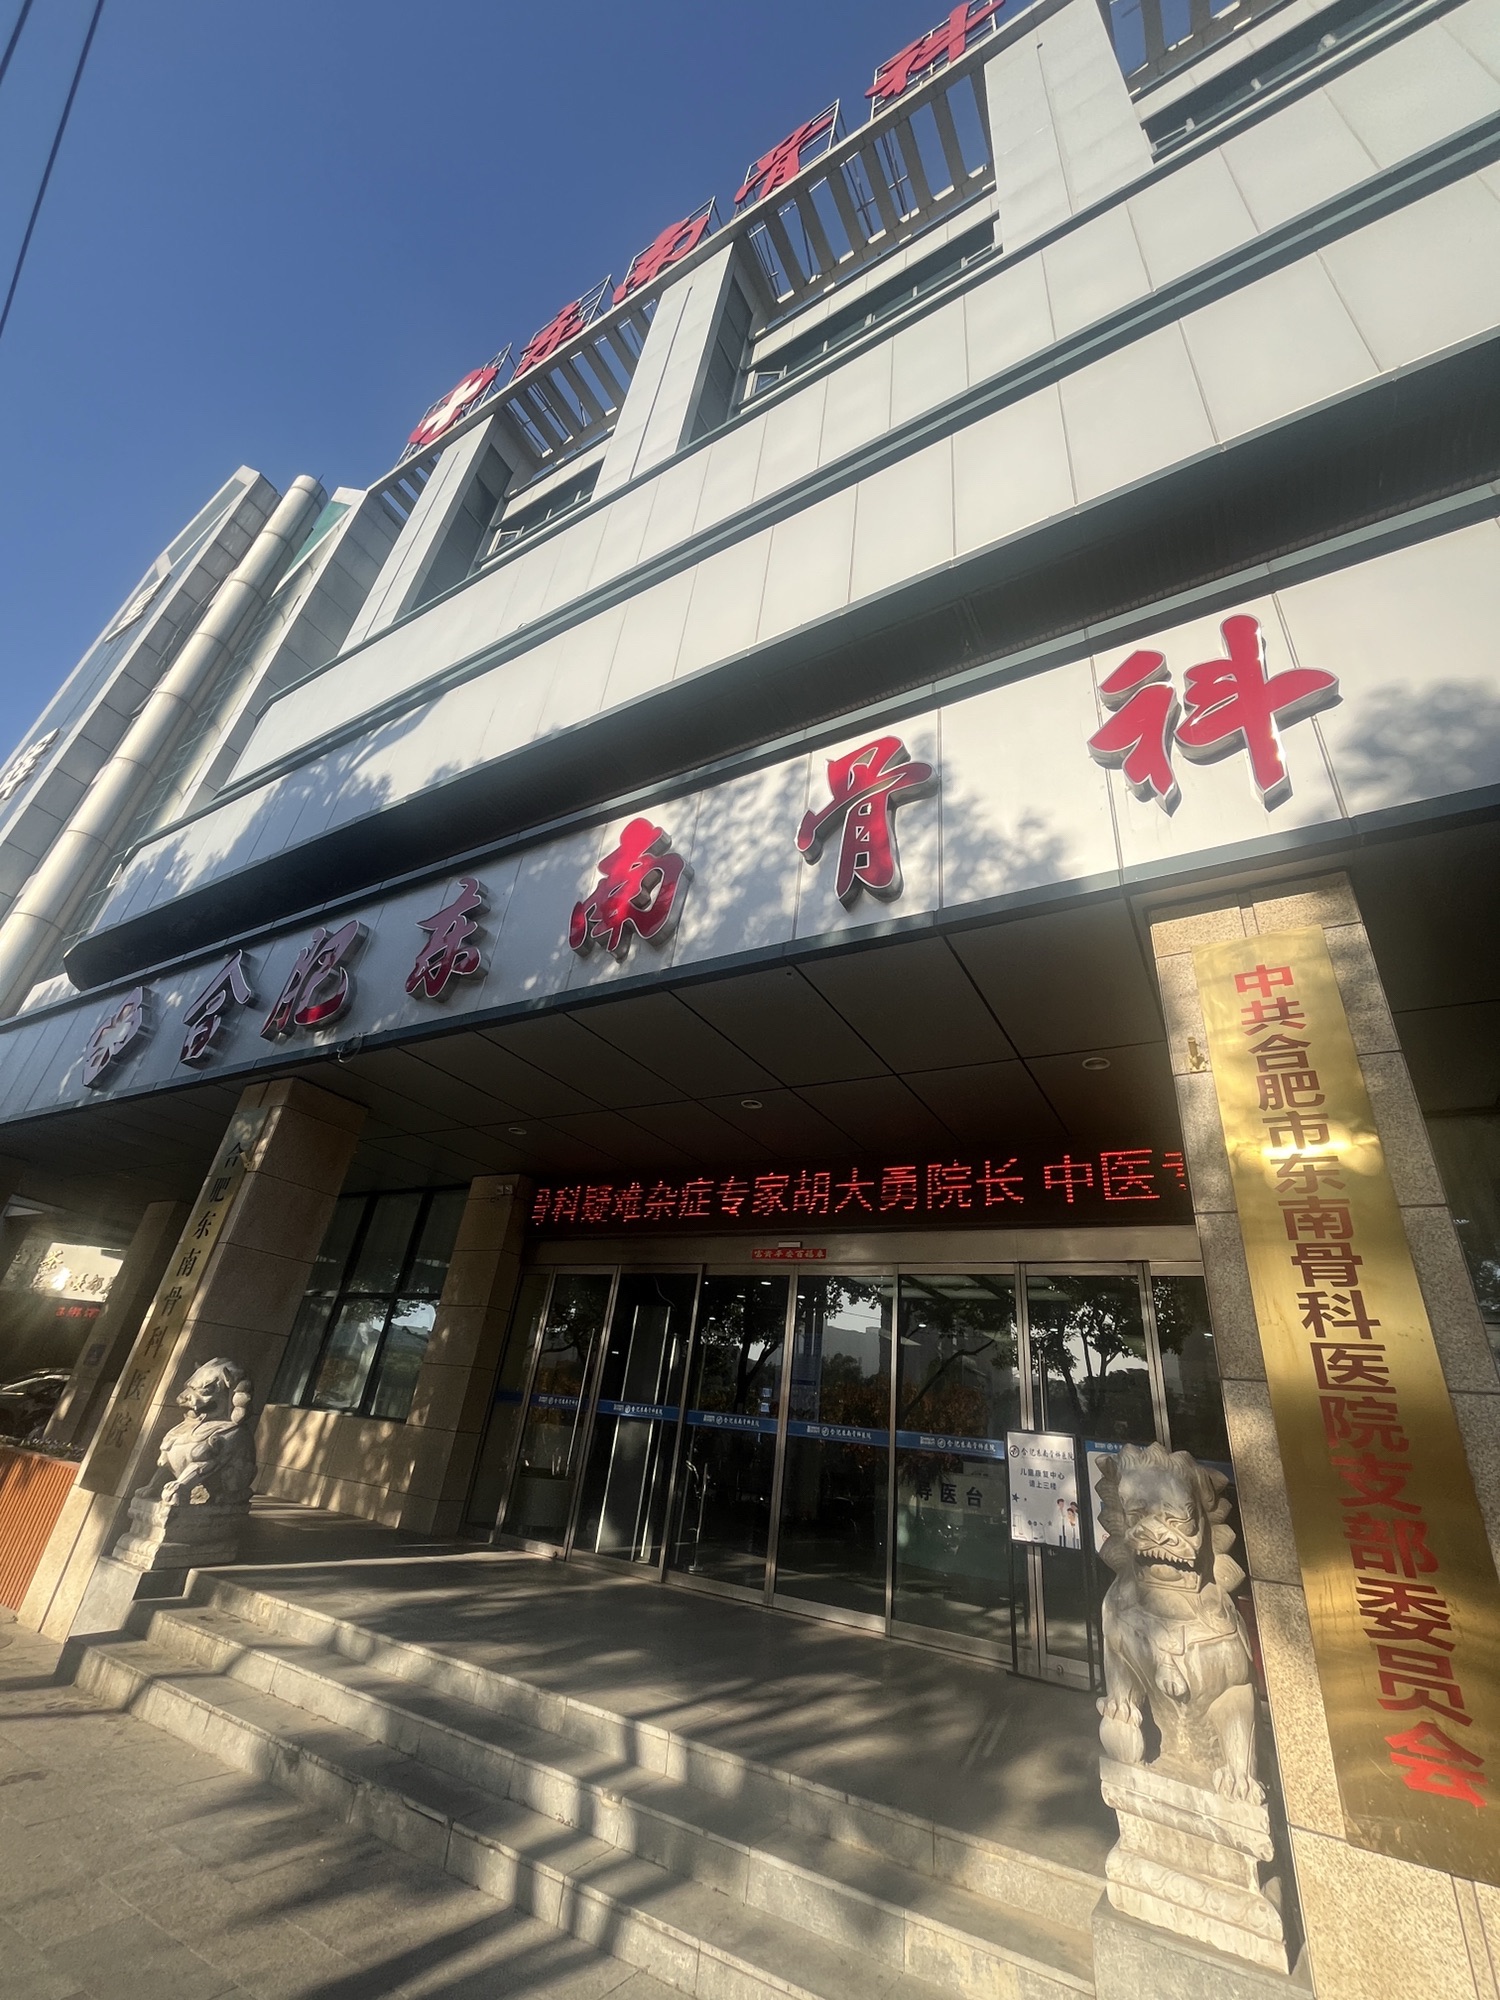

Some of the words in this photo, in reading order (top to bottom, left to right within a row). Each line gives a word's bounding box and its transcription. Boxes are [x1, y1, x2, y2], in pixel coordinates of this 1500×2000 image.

[180, 612, 1342, 1068] 合肥东南骨科
[104, 1140, 246, 1450] 合肥东南骨科医院
[1233, 963, 1489, 1808] 中共合肥市东南骨科医院支部委员会
